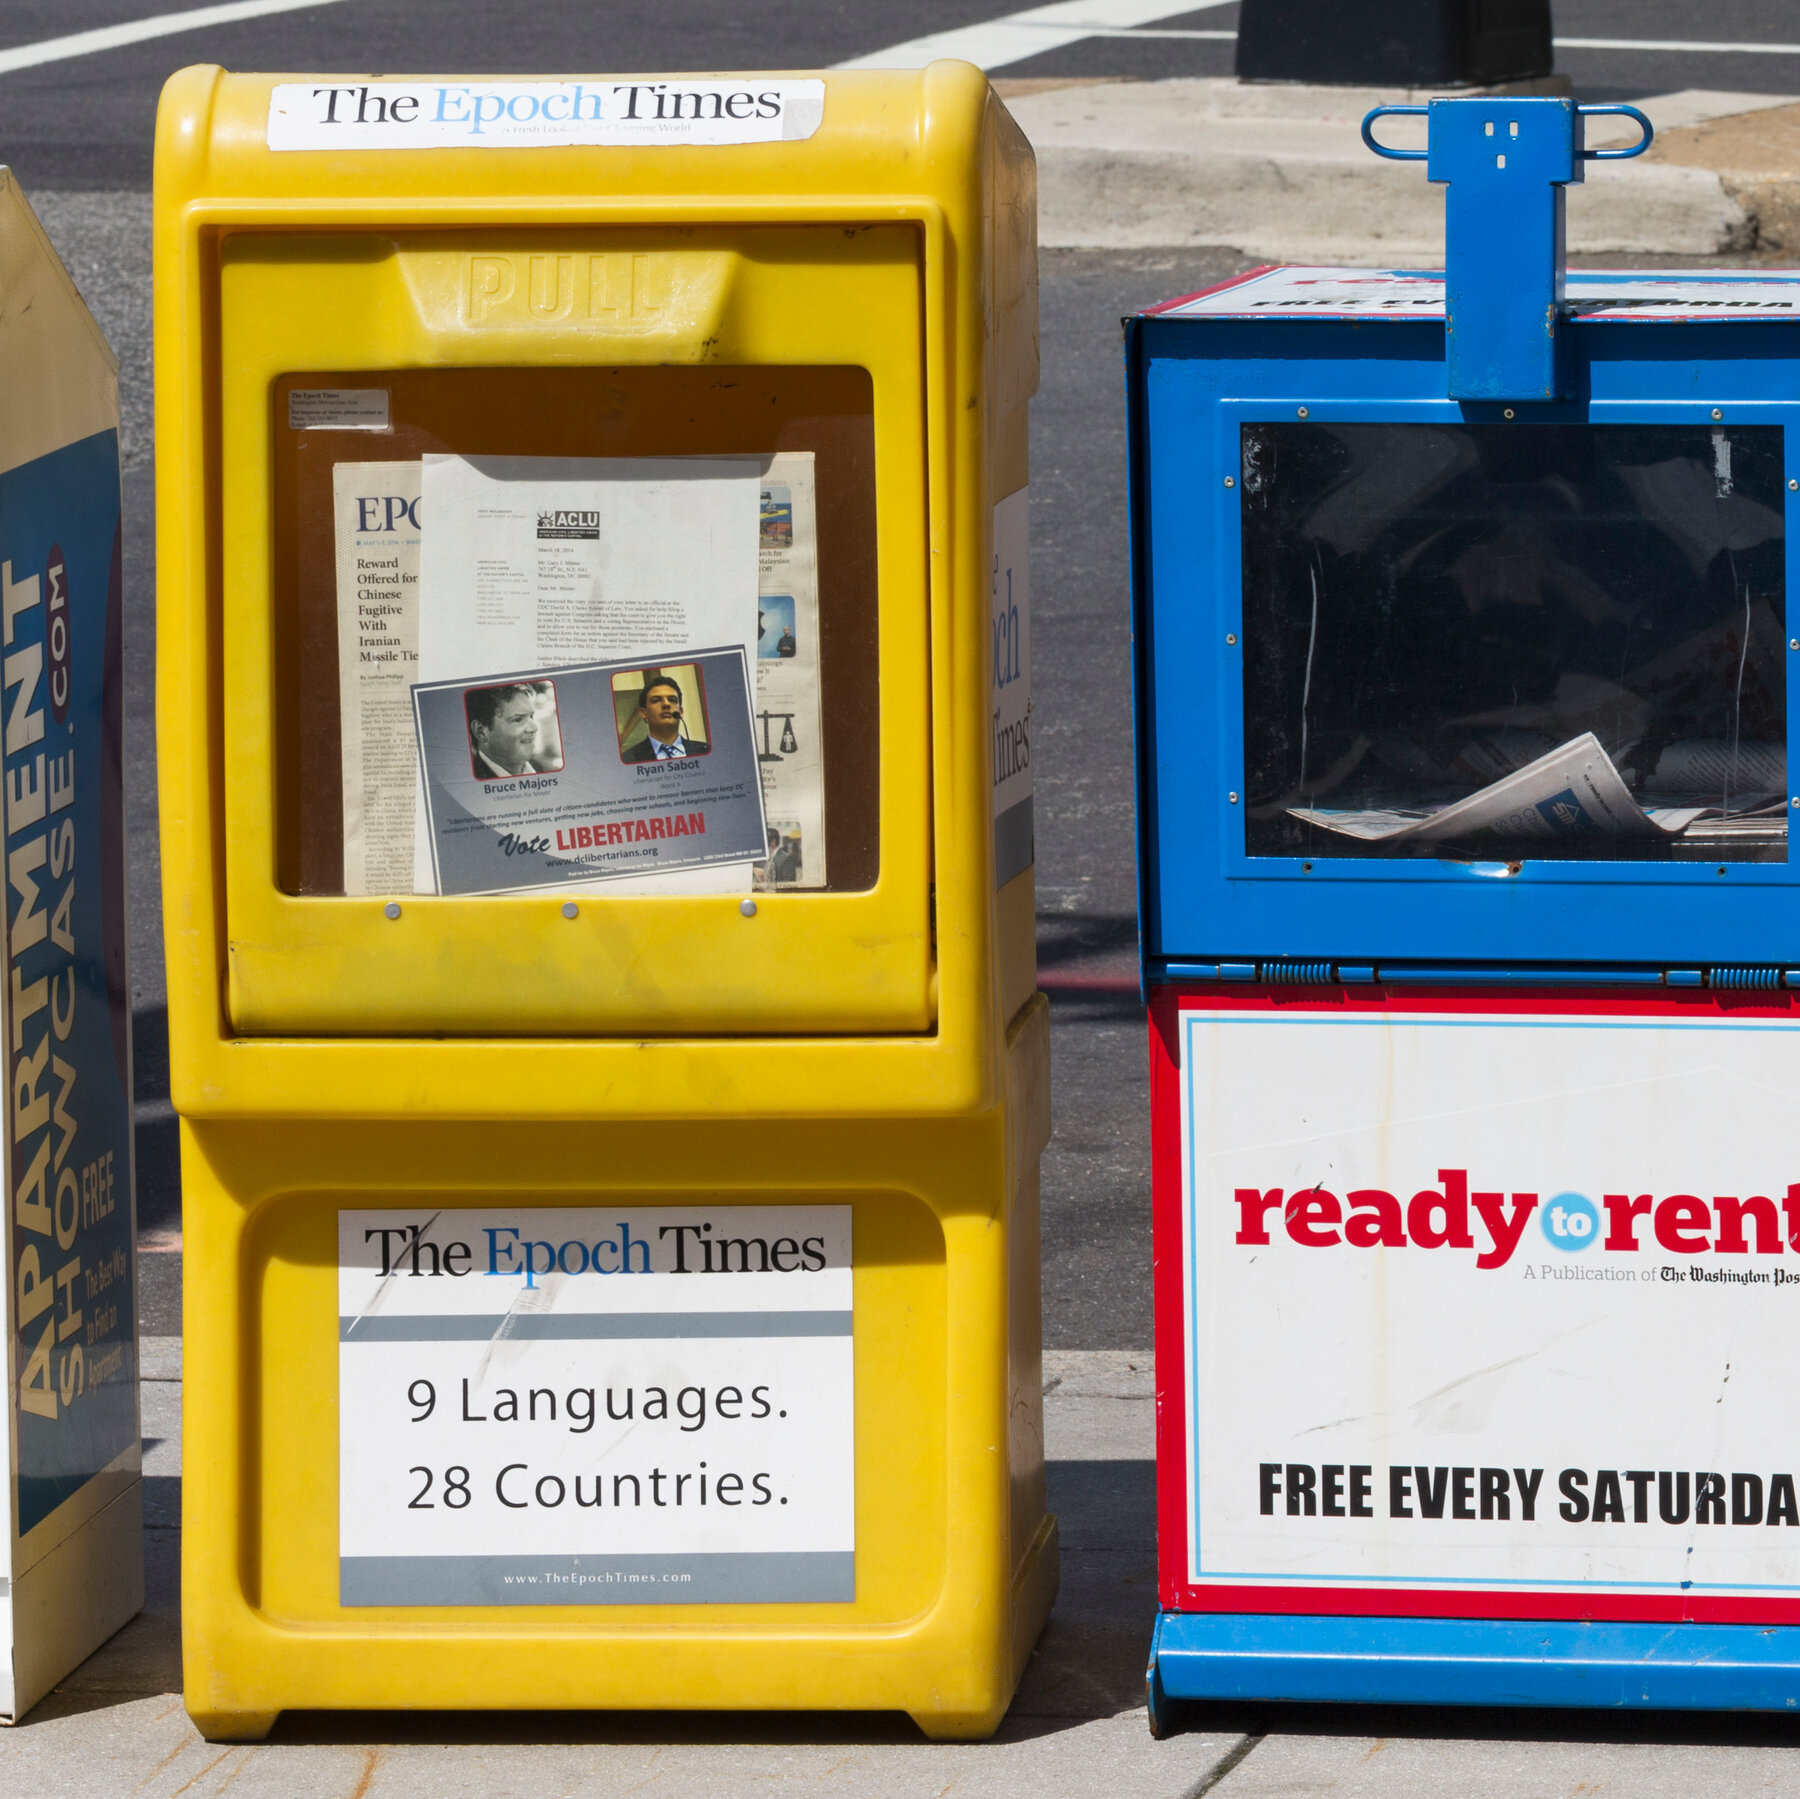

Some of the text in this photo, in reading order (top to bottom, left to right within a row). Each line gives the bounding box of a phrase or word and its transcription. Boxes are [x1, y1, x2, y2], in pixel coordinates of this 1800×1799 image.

[313, 85, 782, 133] The Epoch Times
[468, 255, 661, 321] PULL
[556, 512, 598, 526] ACLU
[357, 557, 399, 569] Reward
[357, 572, 418, 584] Offered for
[358, 589, 402, 600] Chinese
[358, 604, 402, 618] Fugitive
[359, 620, 387, 631] With
[359, 636, 400, 646] Iranian
[360, 651, 398, 662] Missile
[636, 759, 700, 776] Ryan Sabot
[484, 777, 558, 795] Bruce Majors
[498, 812, 522, 820] running
[528, 808, 538, 817] full
[618, 797, 631, 805] who
[680, 788, 704, 798] barriers
[719, 784, 734, 794] keep
[606, 806, 634, 816] choosing
[648, 801, 673, 810] schools,
[674, 799, 686, 807] and
[686, 796, 717, 806] beginning
[497, 812, 706, 857] Vote LIBERTARIAN
[545, 847, 659, 868] www.dclibertarians.org
[2, 559, 58, 1420] APARTMENT
[82, 1150, 115, 1230] FREE
[1234, 1168, 1539, 1270] ready
[1551, 1203, 1592, 1238] to
[365, 1222, 827, 1290] The Epoch Times
[1523, 1265, 1537, 1280] A
[1541, 1264, 1637, 1282] Publication
[1641, 1267, 1658, 1282] of
[1660, 1266, 1687, 1283] The
[1689, 1265, 1771, 1287] Washington
[406, 1377, 789, 1433] 9 Languages.
[407, 1461, 789, 1509] 28 Countries.
[1259, 1463, 1800, 1527] FREE EVERY SATURDA
[504, 1571, 692, 1586] www.TheEpochTimes.com
